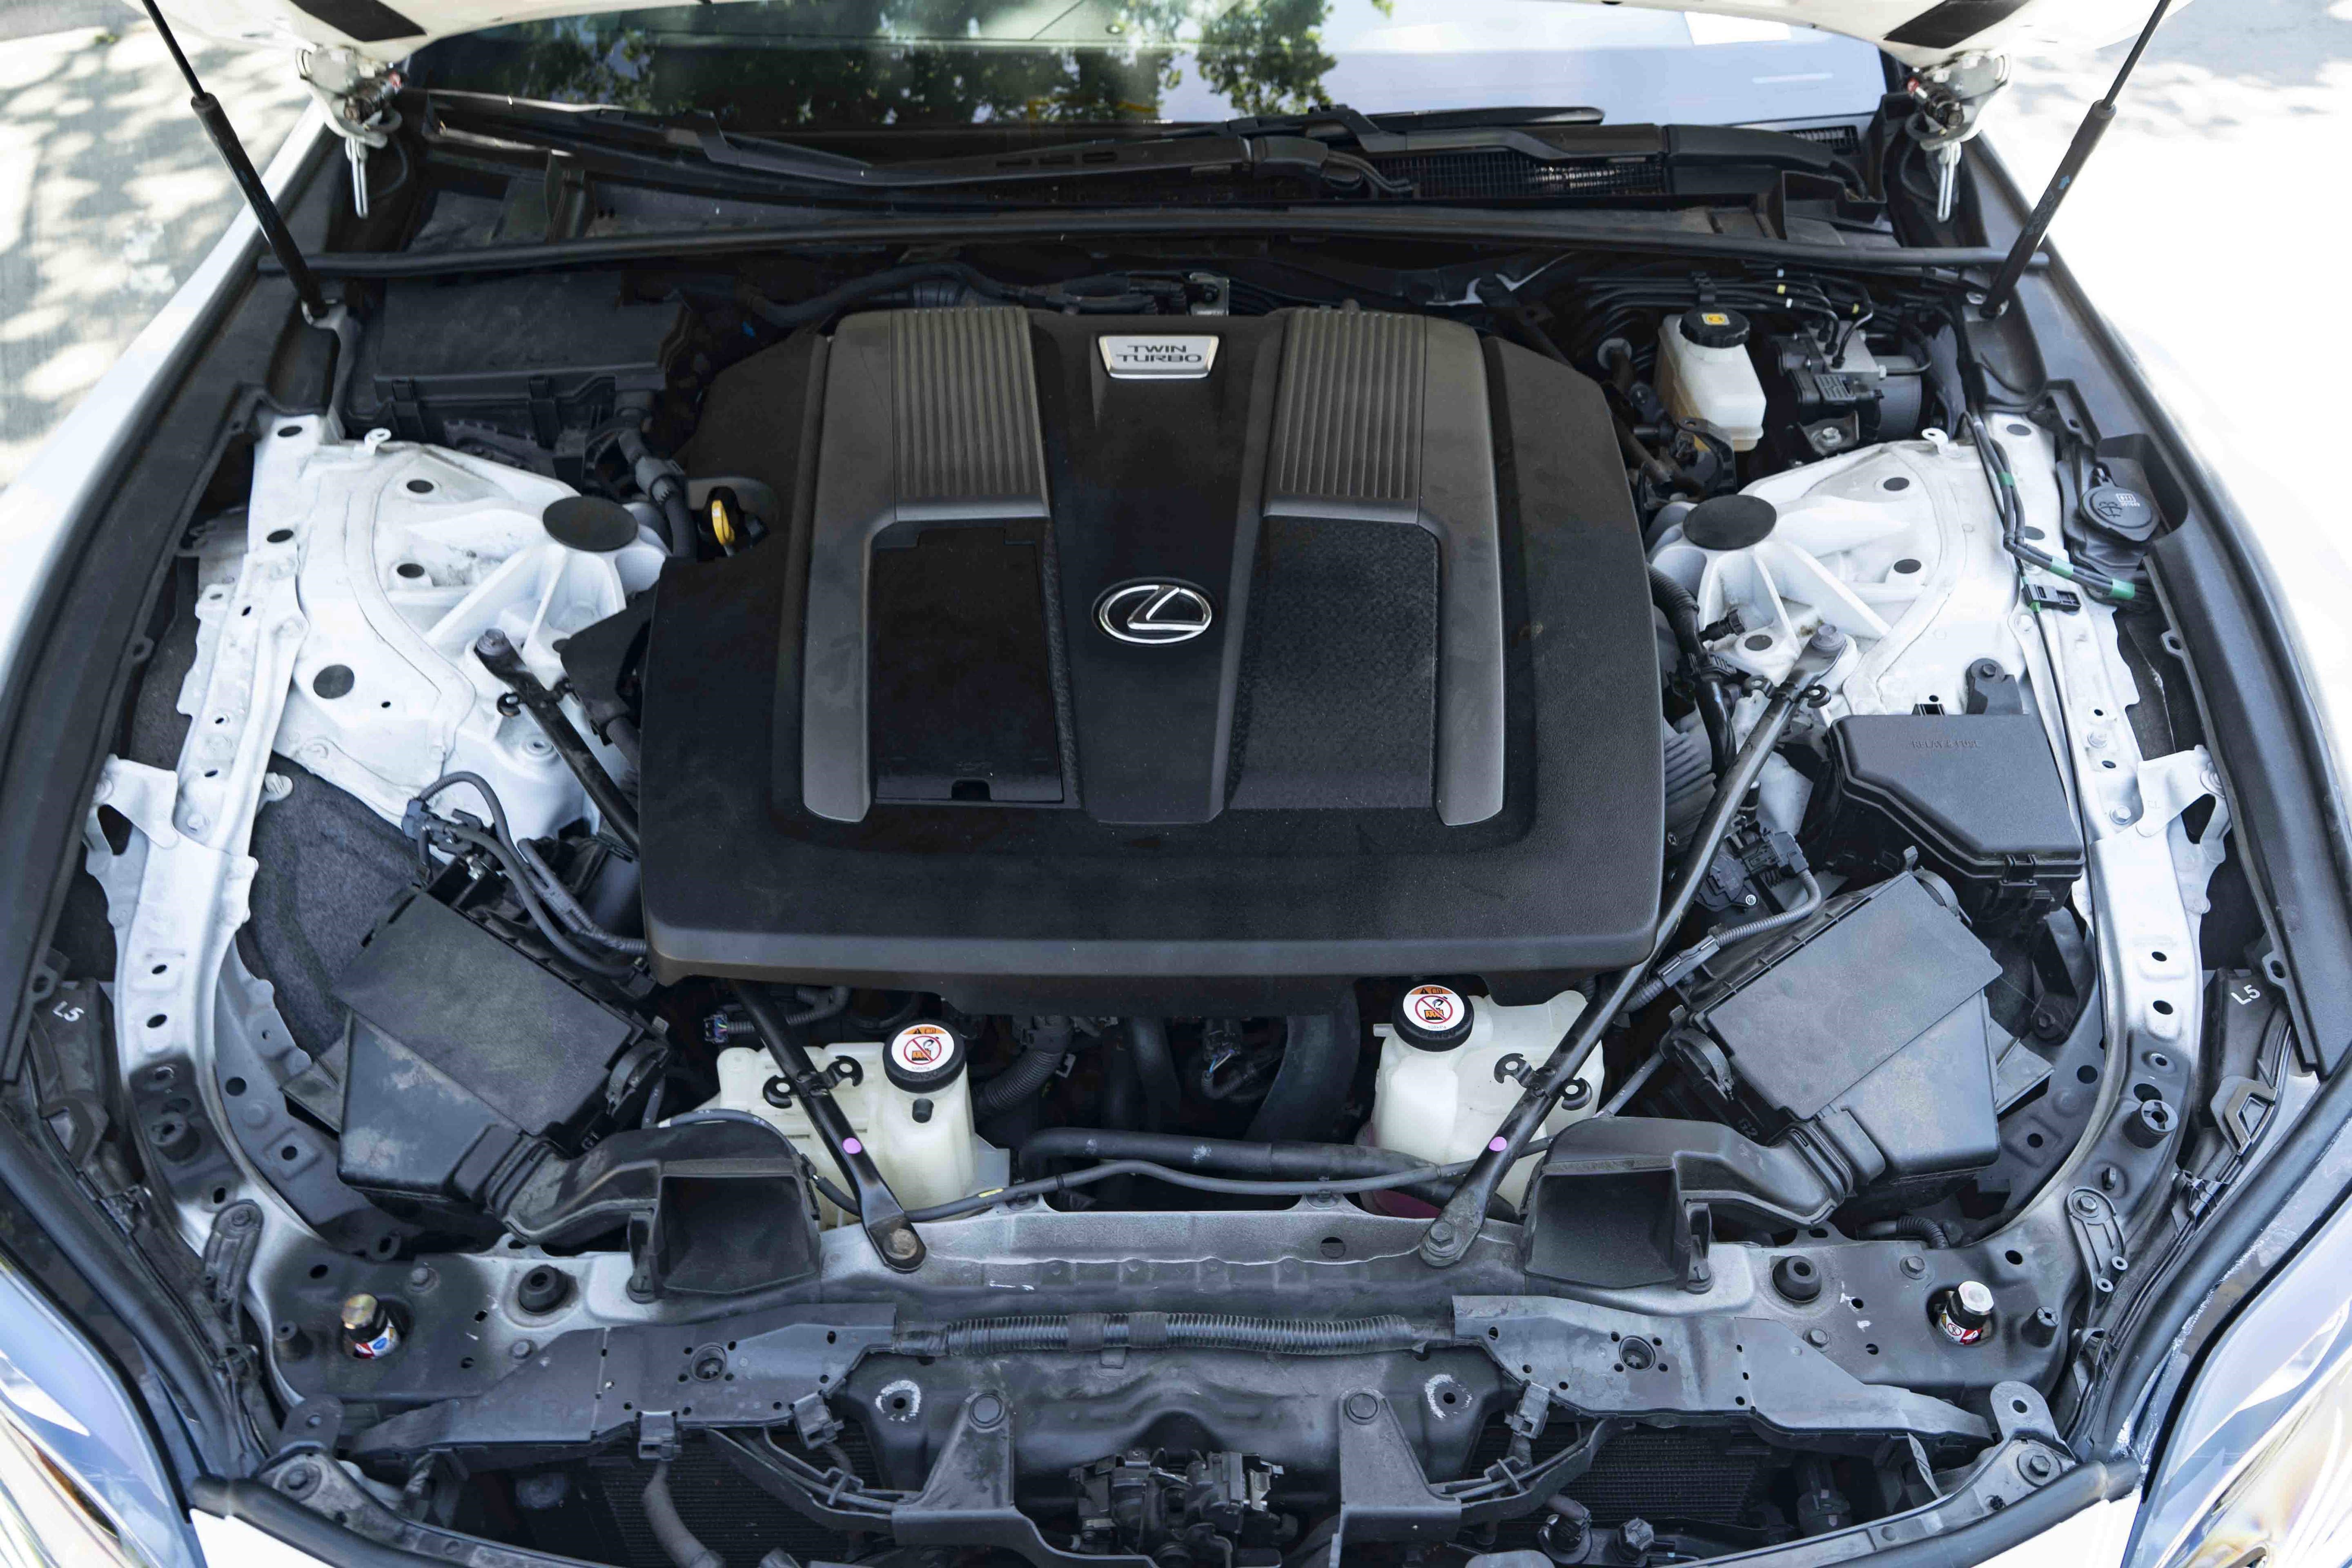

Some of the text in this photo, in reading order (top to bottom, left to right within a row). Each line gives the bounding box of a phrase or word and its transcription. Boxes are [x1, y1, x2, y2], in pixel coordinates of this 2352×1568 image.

[1116, 354, 1202, 363] TURBO
[2231, 984, 2261, 1004] L5
[52, 1001, 85, 1022] L5
